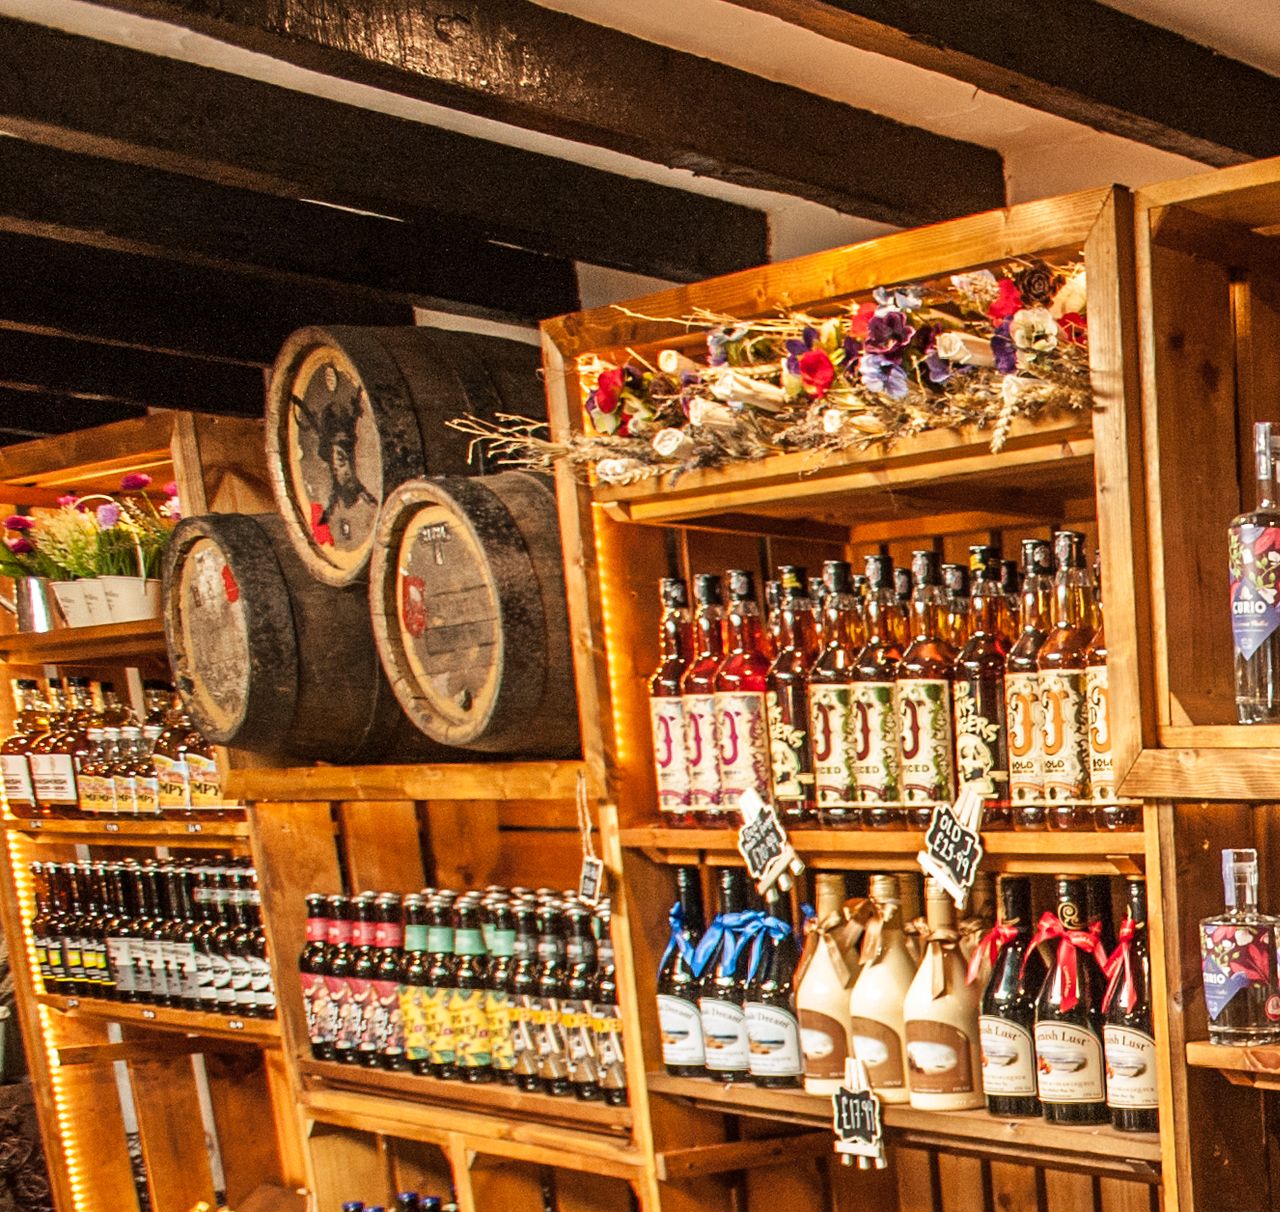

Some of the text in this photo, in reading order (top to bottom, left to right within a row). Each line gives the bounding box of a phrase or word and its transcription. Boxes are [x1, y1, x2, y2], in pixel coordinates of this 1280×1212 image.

[939, 817, 972, 855] OLD J
[1062, 1032, 1086, 1046] Lust
